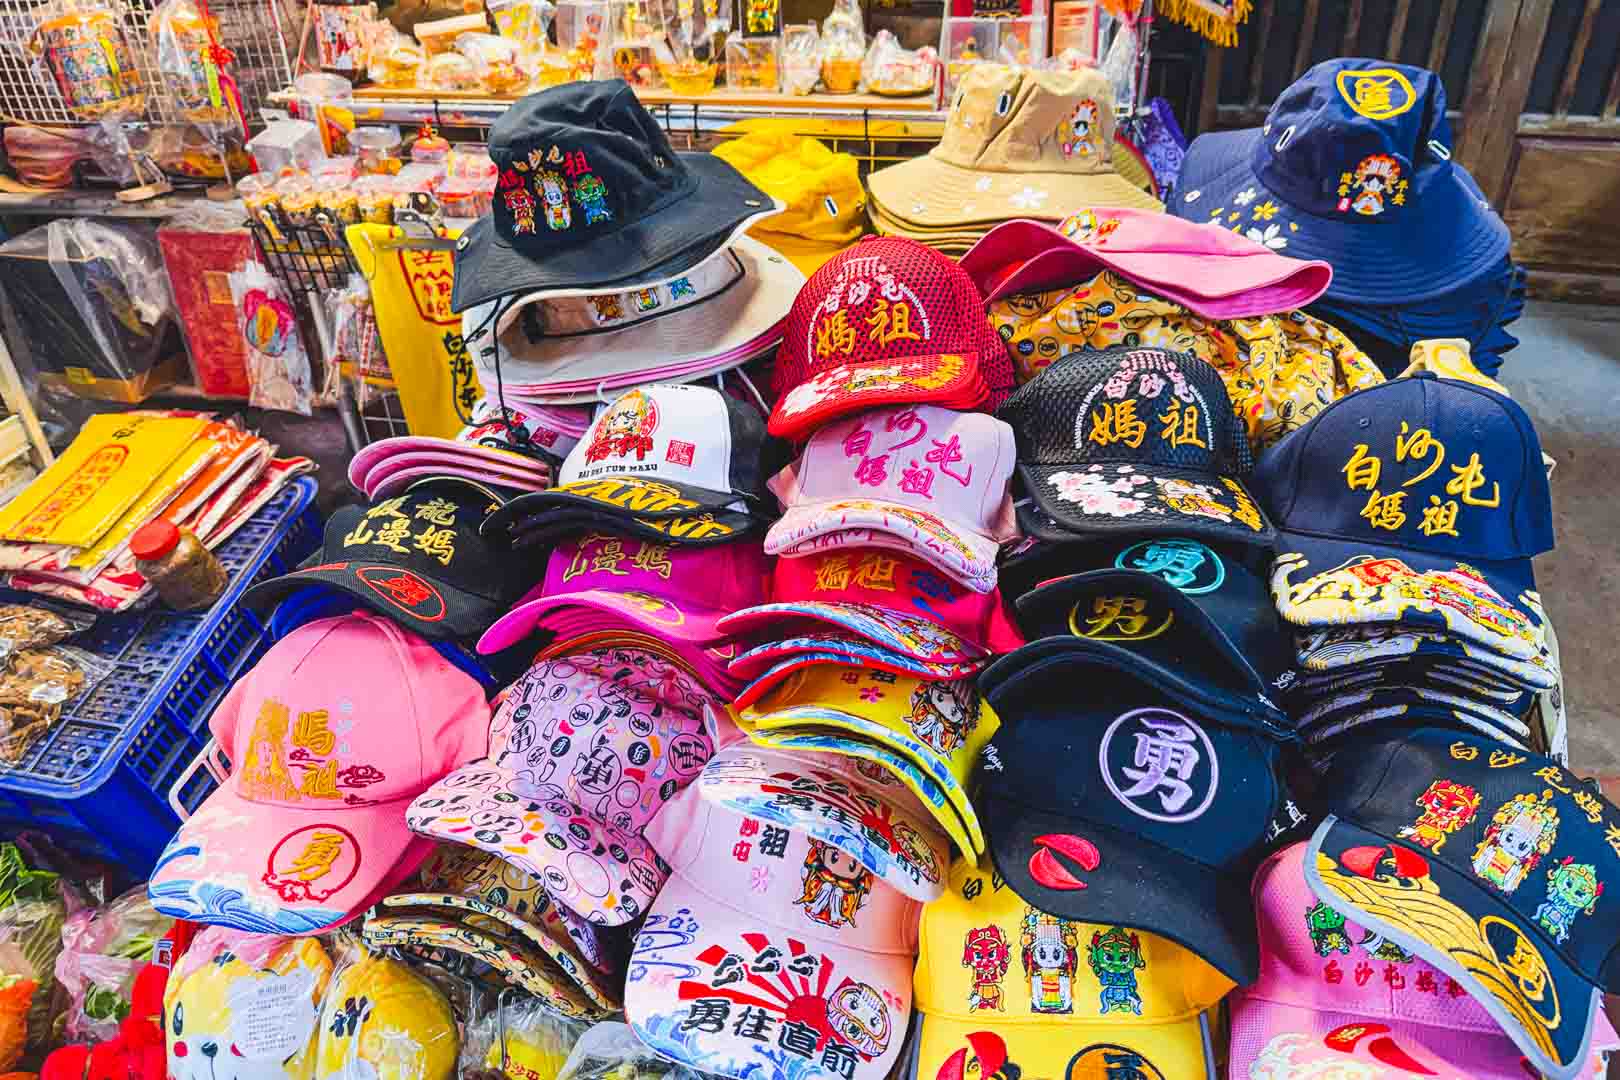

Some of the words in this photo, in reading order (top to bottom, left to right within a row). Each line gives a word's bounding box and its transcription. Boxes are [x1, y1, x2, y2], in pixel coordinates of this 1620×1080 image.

[816, 299, 920, 358] 媽祖
[1088, 396, 1207, 449] 媽祖
[629, 463, 658, 472] MAZU
[1342, 421, 1500, 508] 白沙屯
[1359, 490, 1459, 537] 媽祖
[1121, 718, 1199, 813] 勇
[280, 832, 345, 881] 勇
[759, 824, 790, 859] 祖
[680, 998, 860, 1080] 勇往直前
